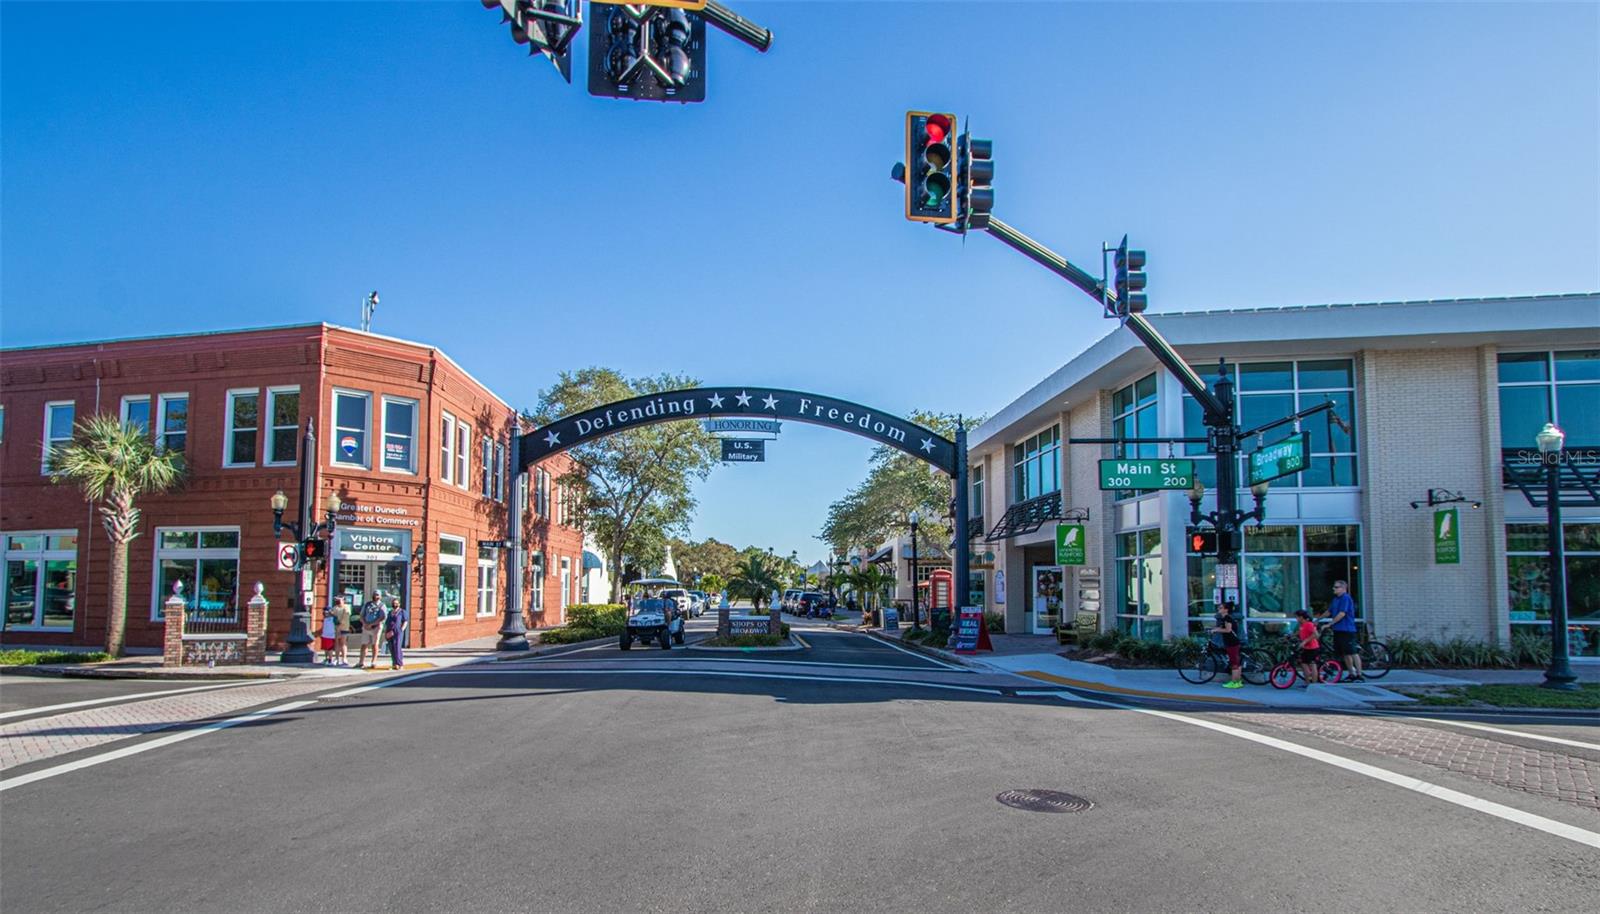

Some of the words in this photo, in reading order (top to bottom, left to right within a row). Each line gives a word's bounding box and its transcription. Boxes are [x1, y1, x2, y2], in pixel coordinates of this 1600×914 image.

[574, 398, 695, 436] Defending
[799, 398, 907, 443] Freedom
[714, 420, 773, 431] HONORING
[733, 441, 753, 449] U.S.
[728, 452, 759, 461] Military
[1256, 443, 1293, 466] Broadway
[1286, 455, 1301, 469] 800
[1117, 463, 1152, 474] Main
[1160, 462, 1177, 474] St
[1108, 477, 1131, 486] 300
[1163, 477, 1188, 486] 200
[341, 503, 373, 512] Greater
[375, 505, 408, 515] Dunedin
[376, 516, 419, 526] Commerce
[350, 534, 394, 543] Visitors
[353, 542, 392, 551] Center
[195, 641, 237, 650] MAIN
